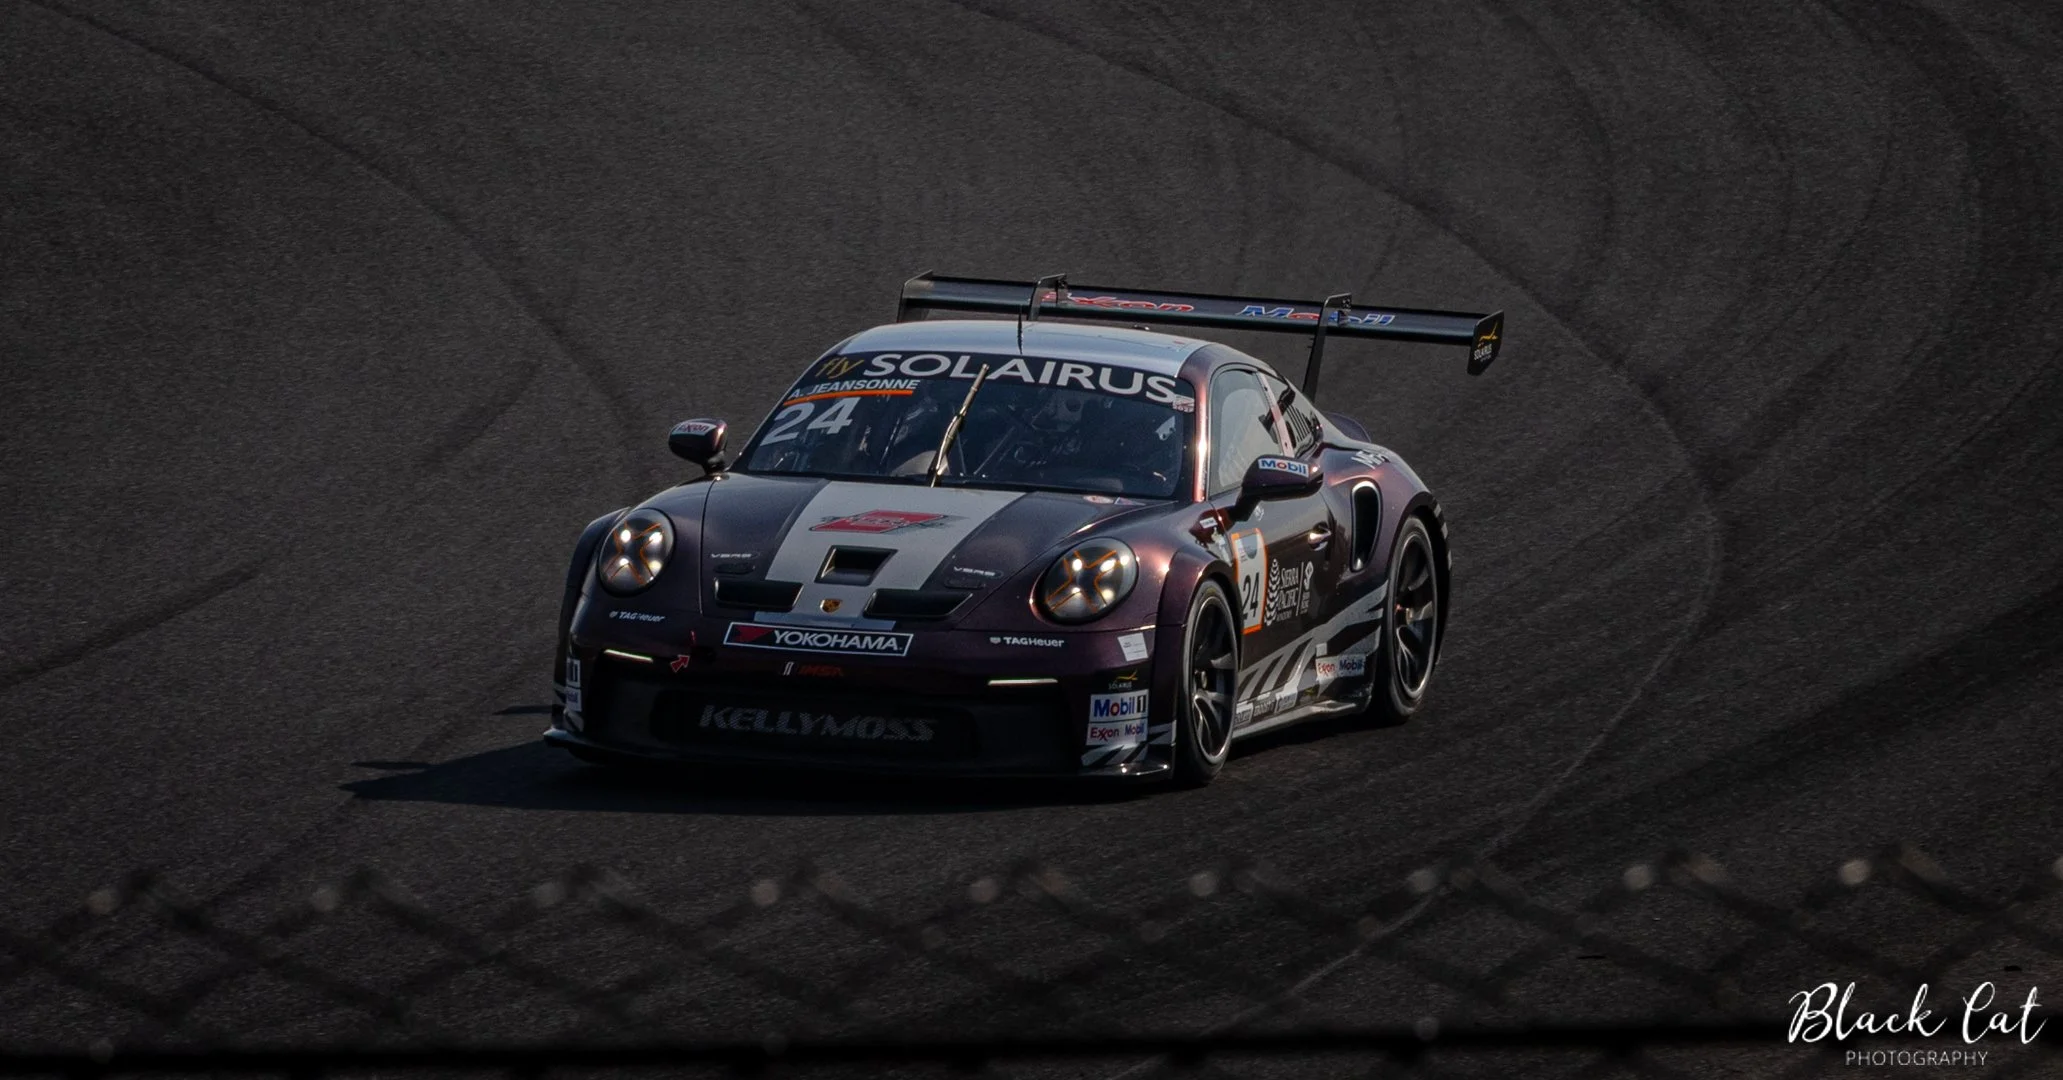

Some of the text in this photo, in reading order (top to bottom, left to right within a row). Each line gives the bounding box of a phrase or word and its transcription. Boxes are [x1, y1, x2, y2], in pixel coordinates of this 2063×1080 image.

[810, 379, 921, 395] JEANSONNE
[815, 353, 1176, 405] fly SOLAIRUS
[757, 397, 861, 447] 24
[1261, 459, 1307, 475] Mobil
[1242, 571, 1260, 621] 24
[773, 629, 898, 651] YOKOHAMA
[1339, 659, 1363, 672] Mobil
[1094, 695, 1147, 717] Mobil 1
[698, 704, 939, 742] KELLYMOSS
[1090, 723, 1145, 742] Exxon Mobil
